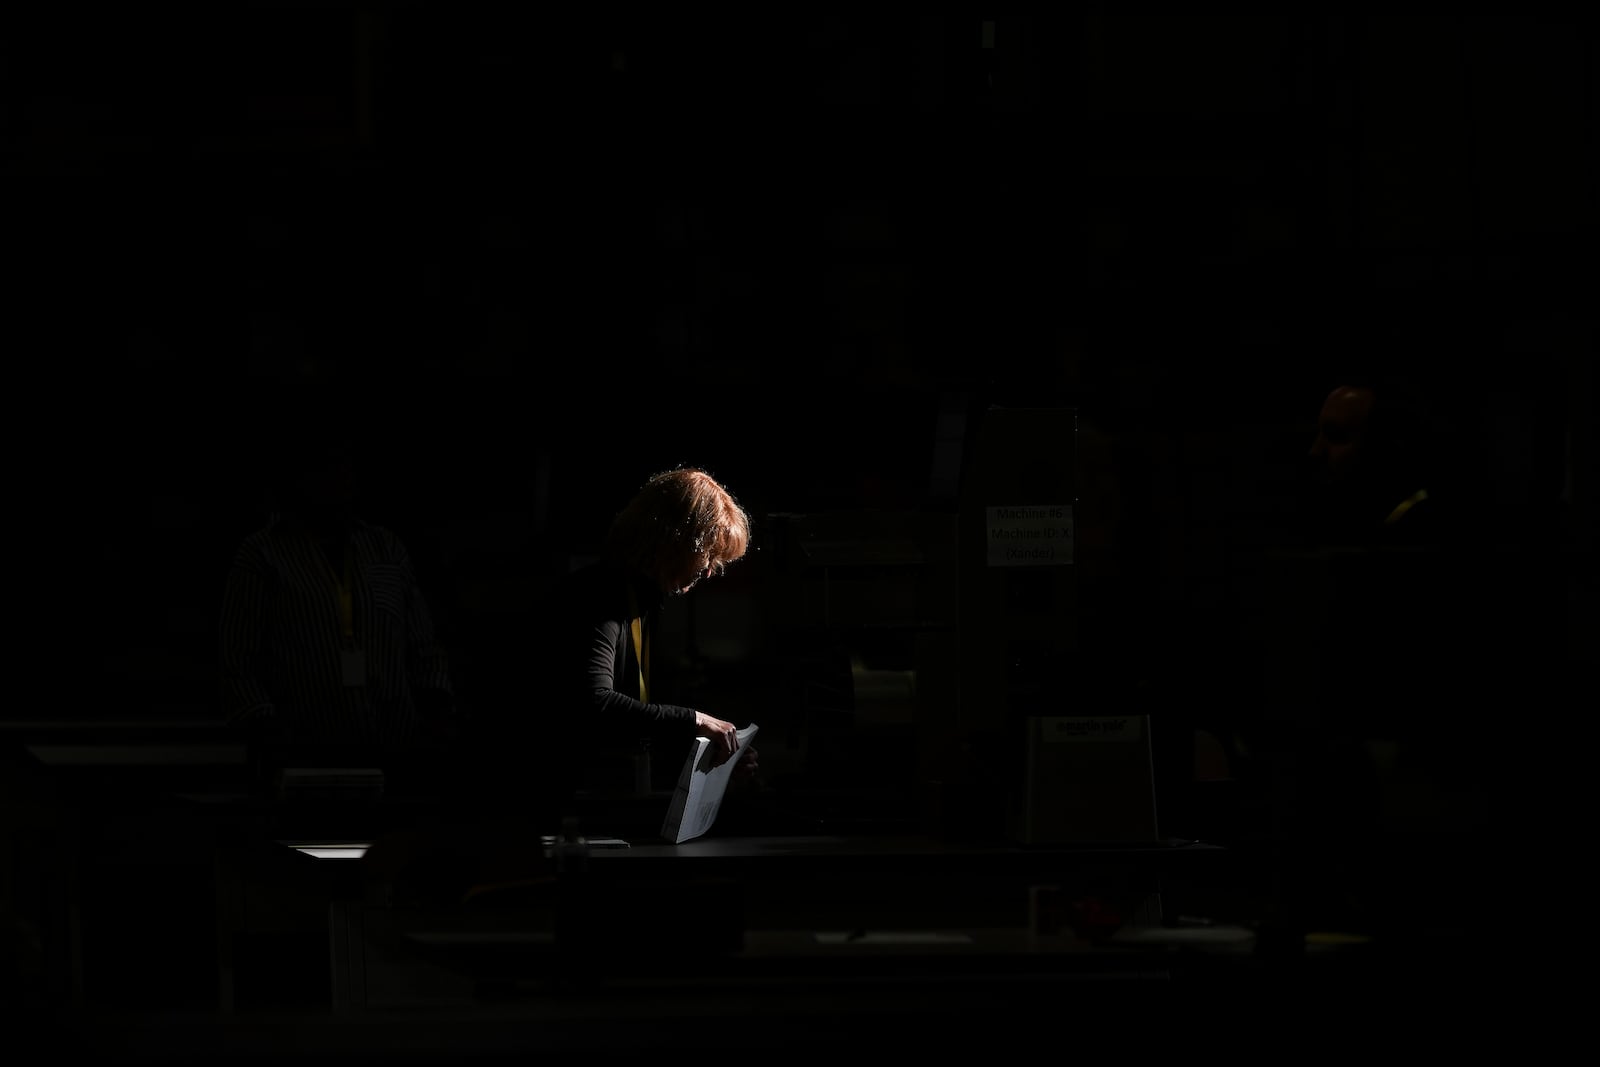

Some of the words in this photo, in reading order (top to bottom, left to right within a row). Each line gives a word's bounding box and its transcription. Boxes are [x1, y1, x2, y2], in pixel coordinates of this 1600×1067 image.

[997, 508, 1047, 519] Machine
[1049, 508, 1063, 519] #6
[991, 528, 1041, 539] Machine
[1043, 528, 1058, 539] ID:
[1061, 528, 1070, 538] X
[1006, 546, 1054, 560] (Xander)
